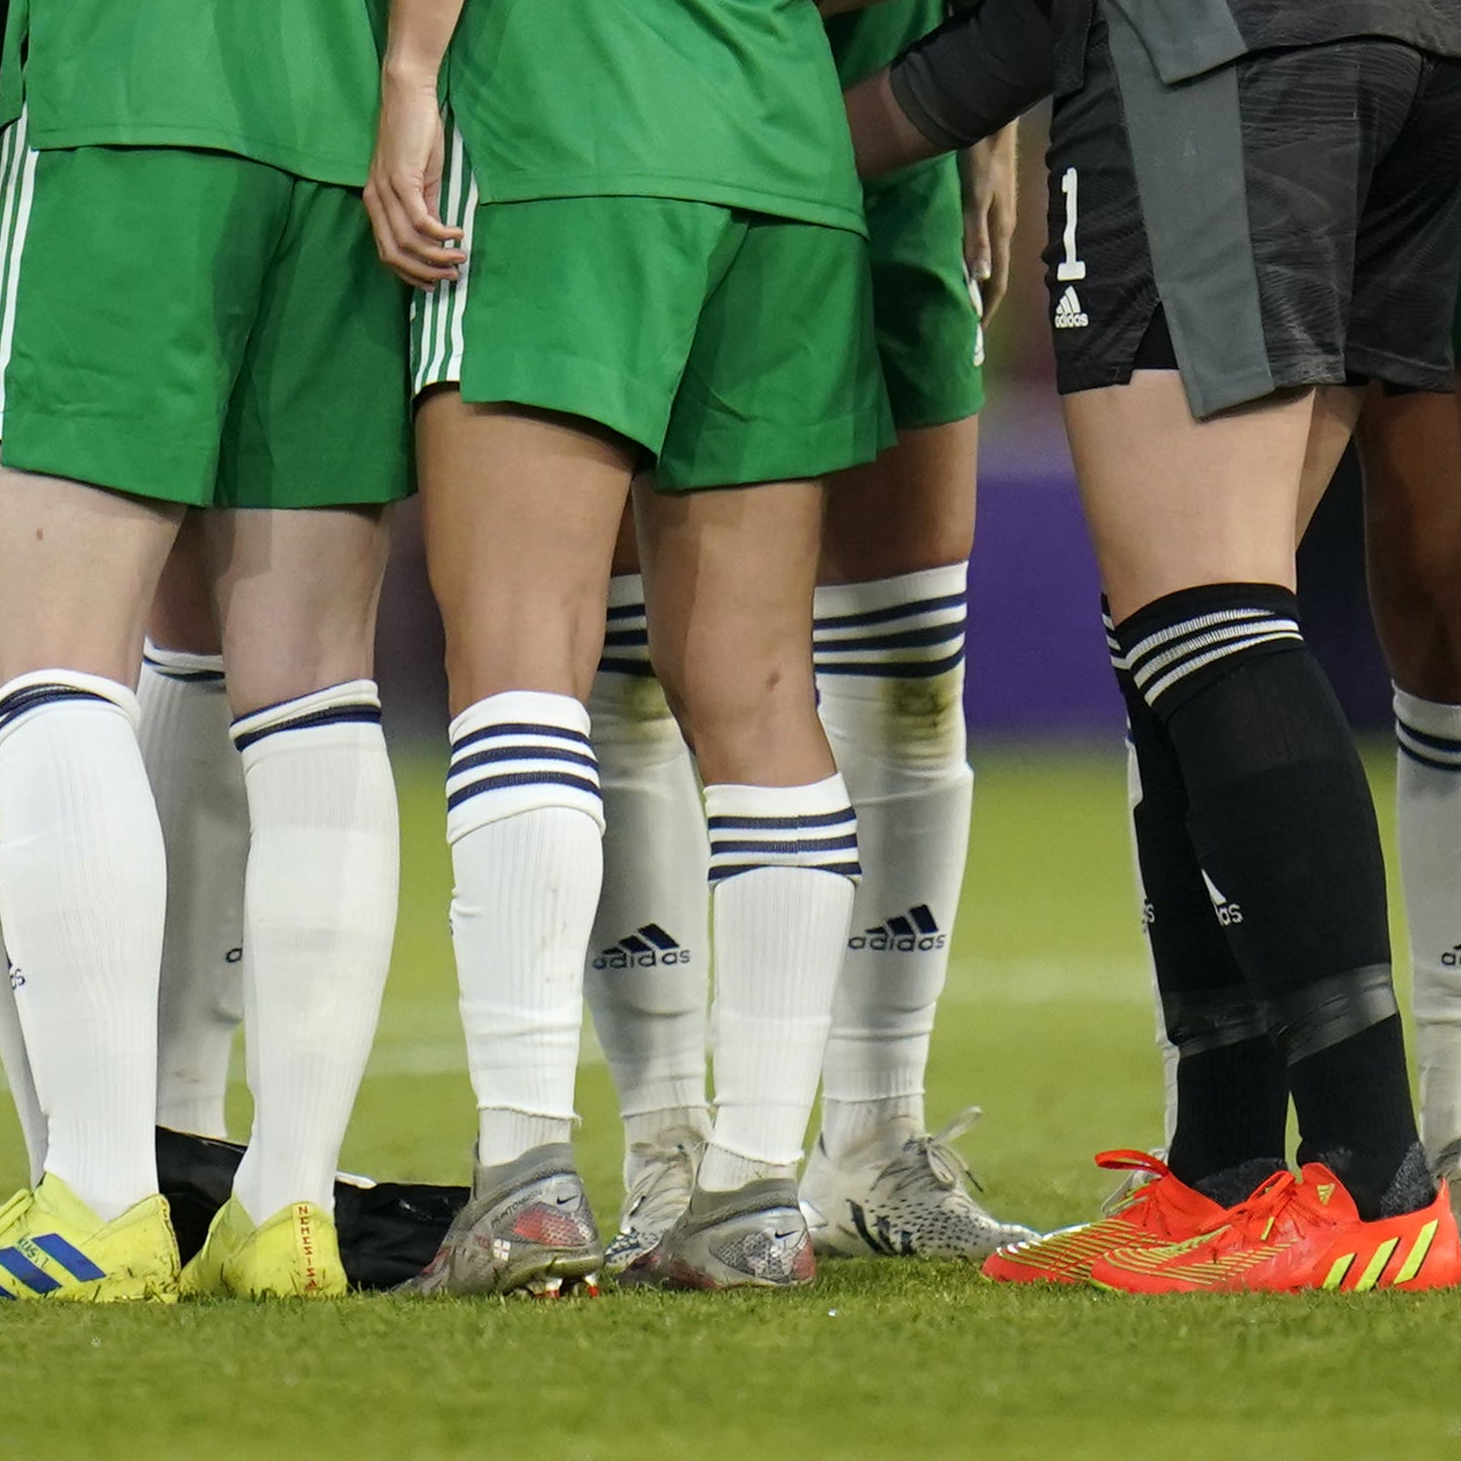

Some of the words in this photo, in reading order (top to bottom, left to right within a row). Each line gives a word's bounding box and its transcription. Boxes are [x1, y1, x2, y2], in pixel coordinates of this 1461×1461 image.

[1057, 167, 1086, 281] 1
[847, 931, 946, 952] adidas
[592, 948, 691, 970] adidas
